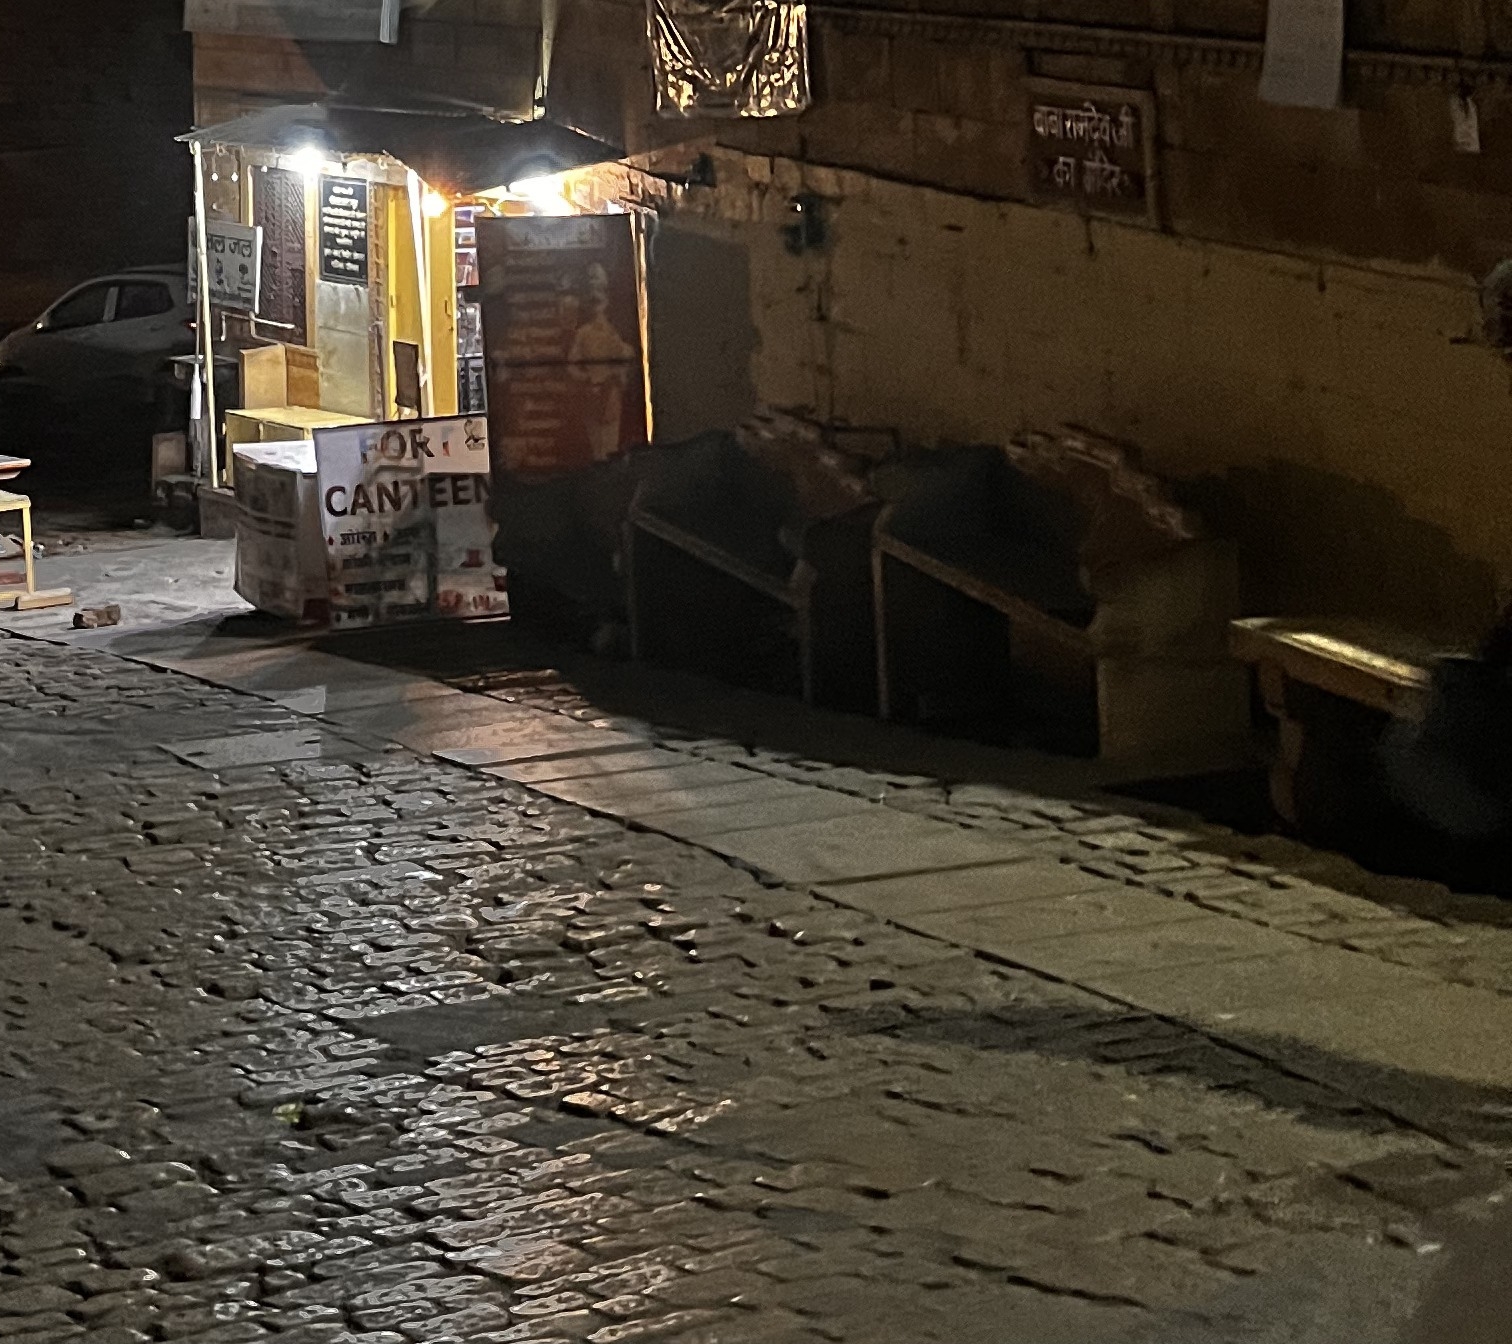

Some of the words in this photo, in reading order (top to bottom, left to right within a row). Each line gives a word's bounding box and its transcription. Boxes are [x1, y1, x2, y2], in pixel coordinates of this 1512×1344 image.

[1033, 105, 1064, 140] बाबा
[1065, 101, 1112, 147] रामदेव
[1112, 104, 1137, 150] जी
[1053, 156, 1076, 191] का
[228, 236, 252, 258] जल
[324, 474, 490, 518] CANTEEN
